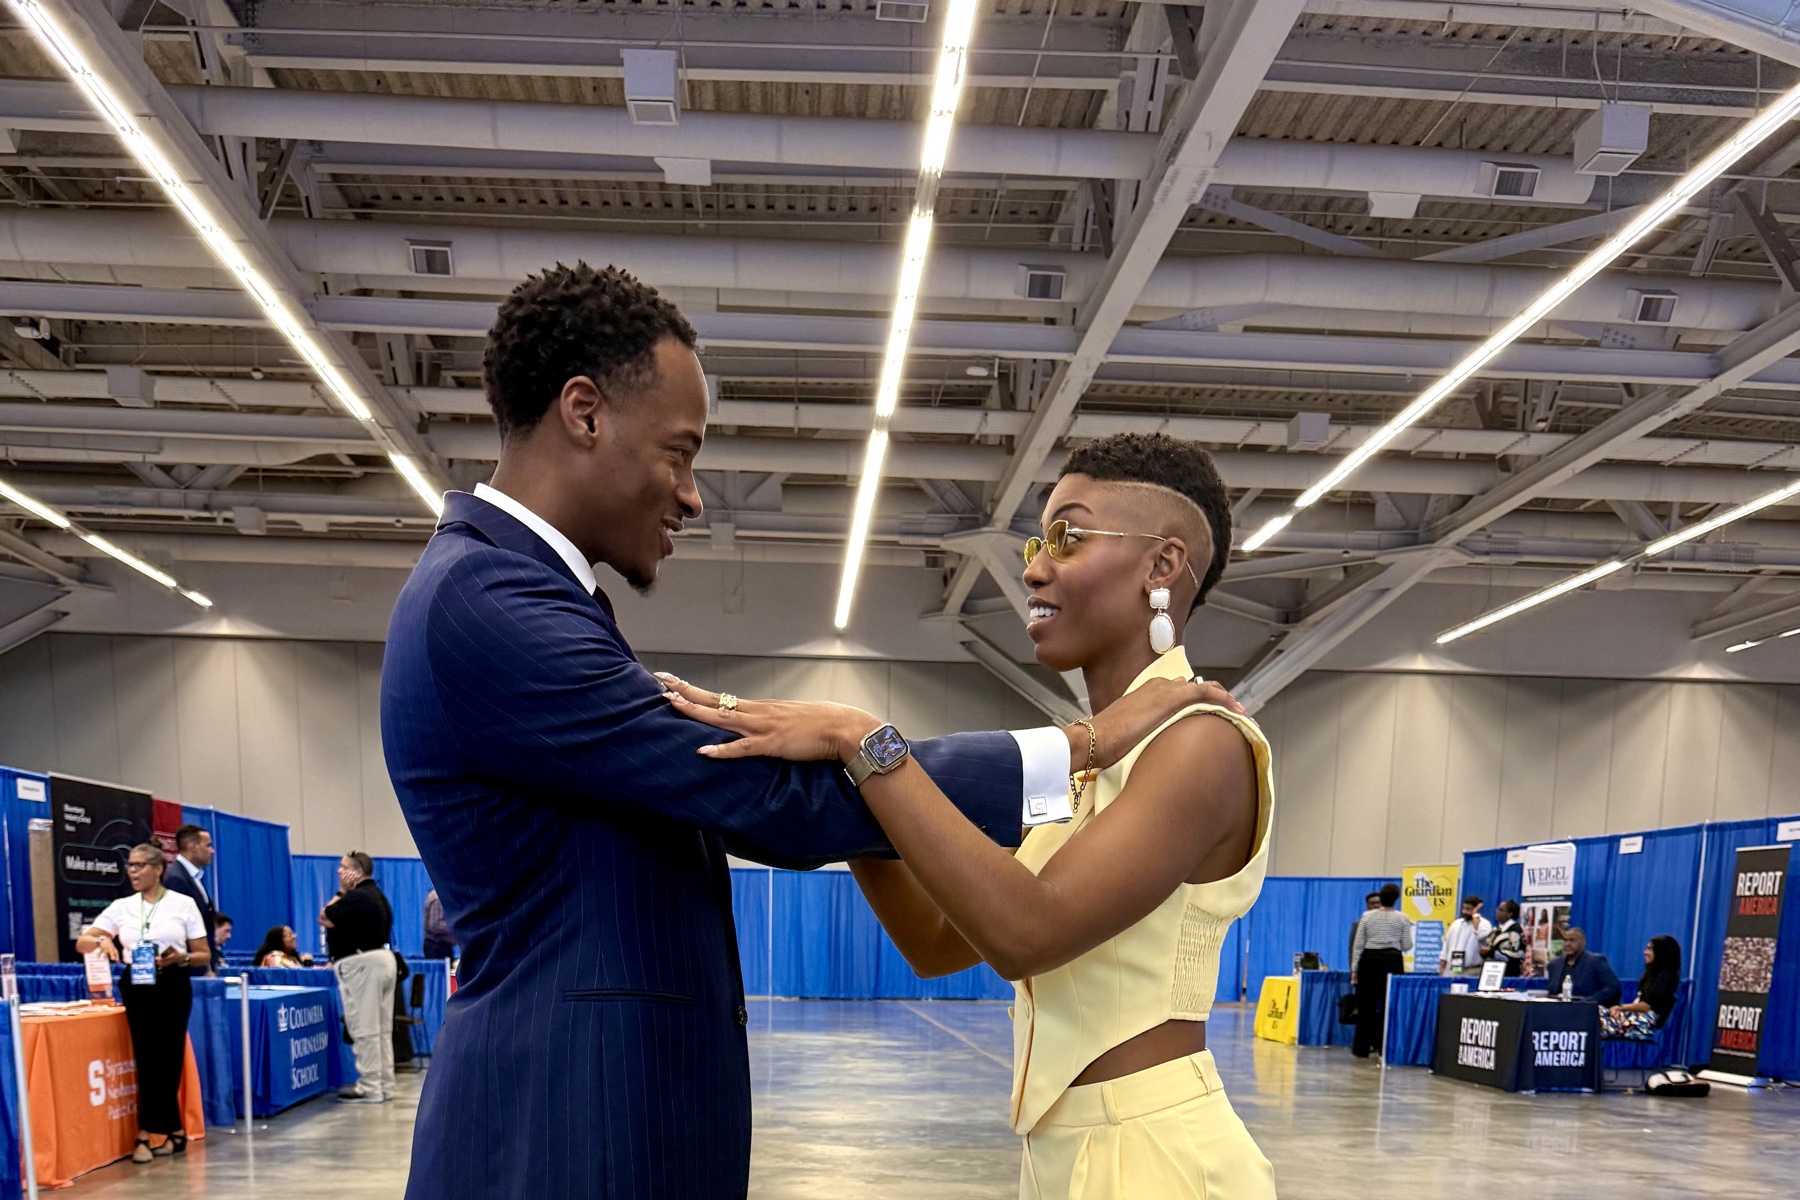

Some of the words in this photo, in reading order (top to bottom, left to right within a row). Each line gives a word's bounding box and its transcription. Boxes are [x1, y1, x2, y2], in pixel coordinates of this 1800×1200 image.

[65, 855, 86, 870] Make
[86, 860, 95, 871] an
[1414, 877, 1433, 888] The
[1527, 867, 1568, 886] WEIGEL
[1736, 871, 1783, 896] REPORT
[1404, 886, 1452, 897] Guardian
[1433, 897, 1445, 907] US
[1738, 897, 1778, 915] AMERICA
[1718, 1004, 1762, 1031] REPORT
[1459, 1017, 1499, 1048] REPORT
[1532, 1031, 1588, 1051] REPORT
[1719, 1029, 1757, 1051] AMERICA
[1462, 1046, 1496, 1071] AMERICA
[1534, 1051, 1586, 1067] AMERICA
[88, 1059, 106, 1107] S
